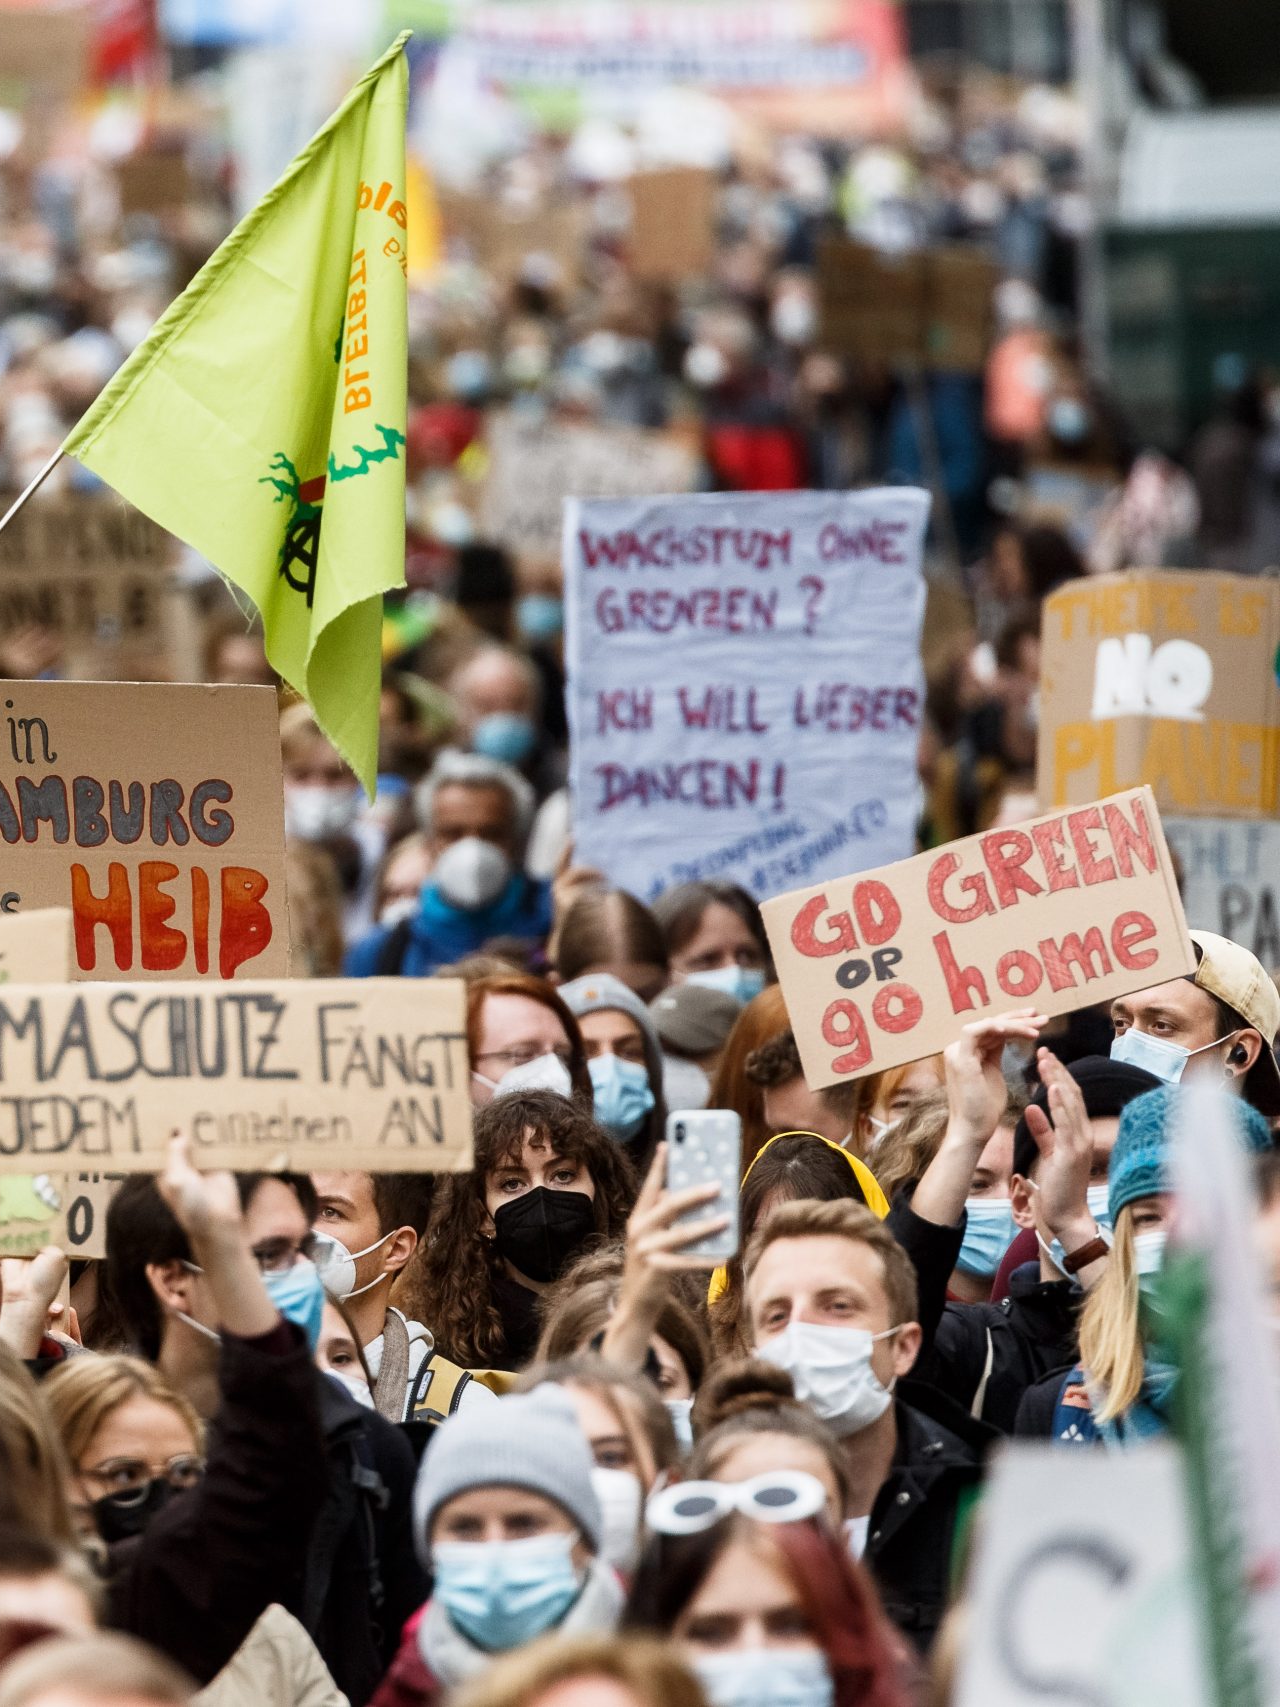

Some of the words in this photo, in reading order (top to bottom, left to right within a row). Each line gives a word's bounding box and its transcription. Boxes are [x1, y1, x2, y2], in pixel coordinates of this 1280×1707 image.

[578, 524, 793, 571] WACHSTUM
[818, 519, 910, 566] OHNE
[1047, 582, 1198, 642] THERE
[1091, 632, 1213, 722] NO
[5, 699, 58, 764] in
[596, 687, 654, 735] ICH
[677, 686, 768, 734] WILL
[793, 683, 920, 733] LIEBER
[790, 880, 903, 958] GO
[927, 797, 1157, 924] GREEN
[821, 982, 924, 1075] go
[931, 910, 1160, 1016] home
[835, 946, 904, 990] OR
[318, 1002, 468, 1089] FÄNGT
[379, 1095, 445, 1146] AN
